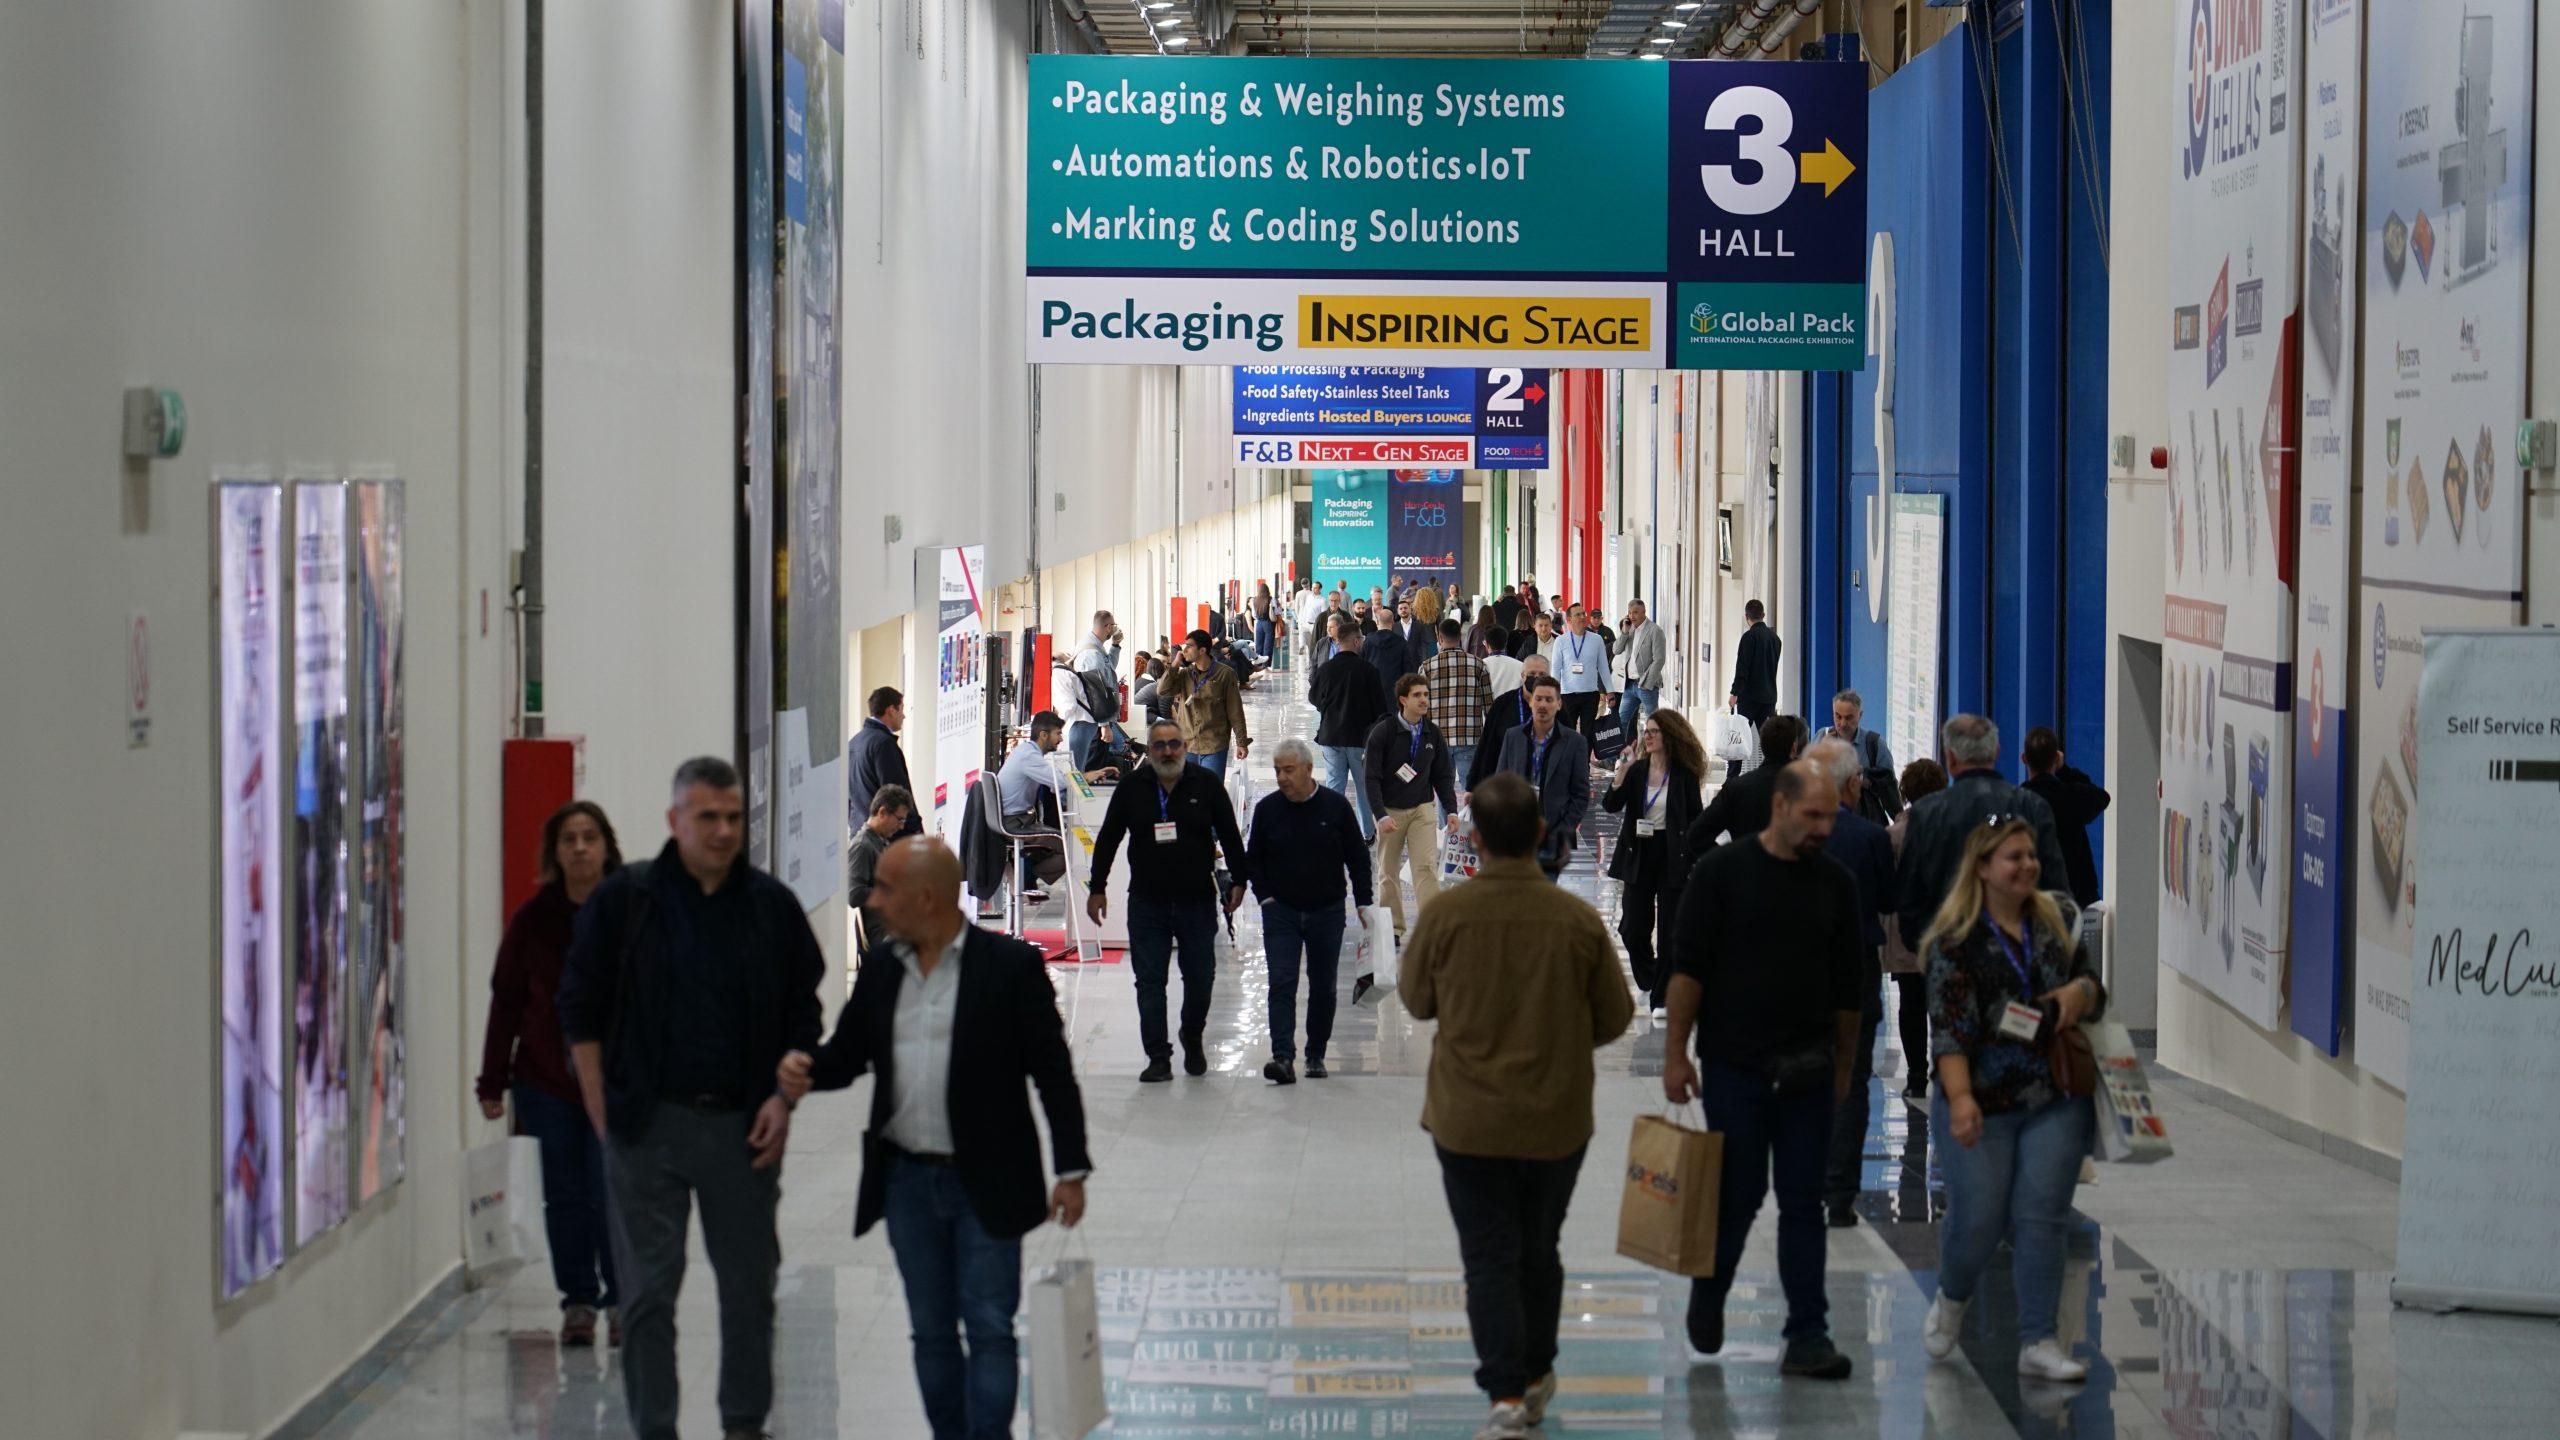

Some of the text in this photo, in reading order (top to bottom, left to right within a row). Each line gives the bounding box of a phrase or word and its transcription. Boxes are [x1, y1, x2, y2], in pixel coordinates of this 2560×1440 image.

[1066, 79, 1565, 127] Packaging & Weighing Systems
[2212, 61, 2262, 165] HELLAS
[1700, 85, 1797, 216] 3
[1065, 143, 1273, 179] Automations
[1286, 146, 1309, 181] &
[1066, 205, 1520, 252] Marking & Coding Solutions
[1699, 228, 1795, 257] HALL
[1041, 297, 1640, 352] Packaging INSPIRING STAGE
[1721, 311, 1856, 333] Global Pack
[1690, 336, 1855, 345] INTERNATIONAL PACKAGING EXHIBITION
[1282, 366, 1346, 378] Processing
[1364, 367, 1425, 379] Packaging
[1247, 385, 1450, 402] Food Safety Stainless Steel Tanks
[1486, 368, 1525, 411] 2
[1247, 408, 1472, 426] Ingredients Hosted Buyers LOUNGE
[1486, 416, 1524, 428] HALL
[1240, 441, 1293, 462] F&B
[1303, 442, 1353, 461] NEXT
[1373, 441, 1408, 461] GEN
[1419, 444, 1465, 462] STAGE
[1324, 498, 1373, 510] Packaging
[1329, 509, 1369, 518] INSPIRING
[1323, 518, 1374, 527] Innovation
[1404, 507, 1446, 527] F&B
[1330, 557, 1382, 566] Global Pack
[2447, 716, 2479, 735] Self
[2484, 716, 2544, 736] Service
